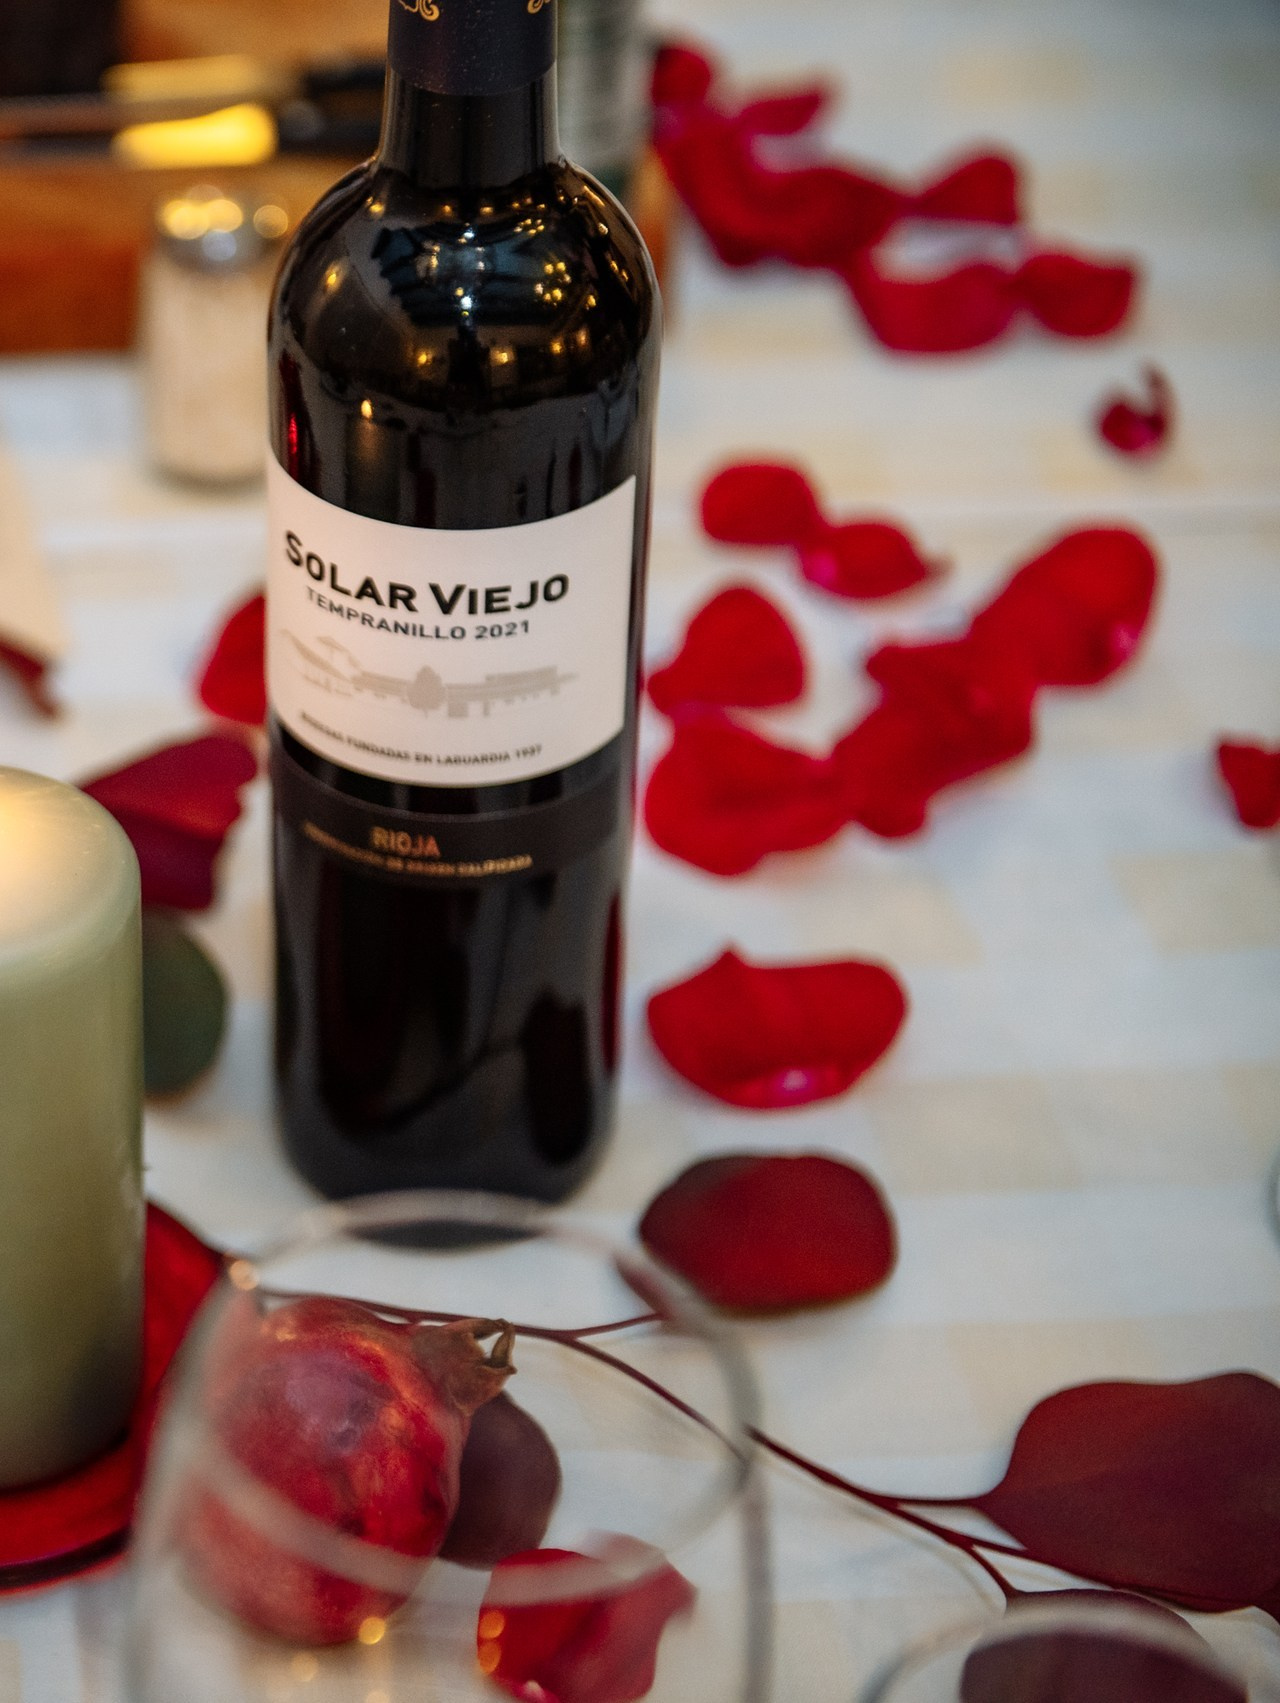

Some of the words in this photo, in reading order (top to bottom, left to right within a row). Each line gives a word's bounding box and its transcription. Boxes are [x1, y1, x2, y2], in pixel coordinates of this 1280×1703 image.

[286, 530, 418, 613] SOLAR
[428, 573, 569, 615] VIEJO
[307, 586, 466, 640] TEMPRANILLO
[475, 620, 529, 639] 2021
[415, 751, 433, 763] EN
[371, 826, 442, 858] RIOJA
